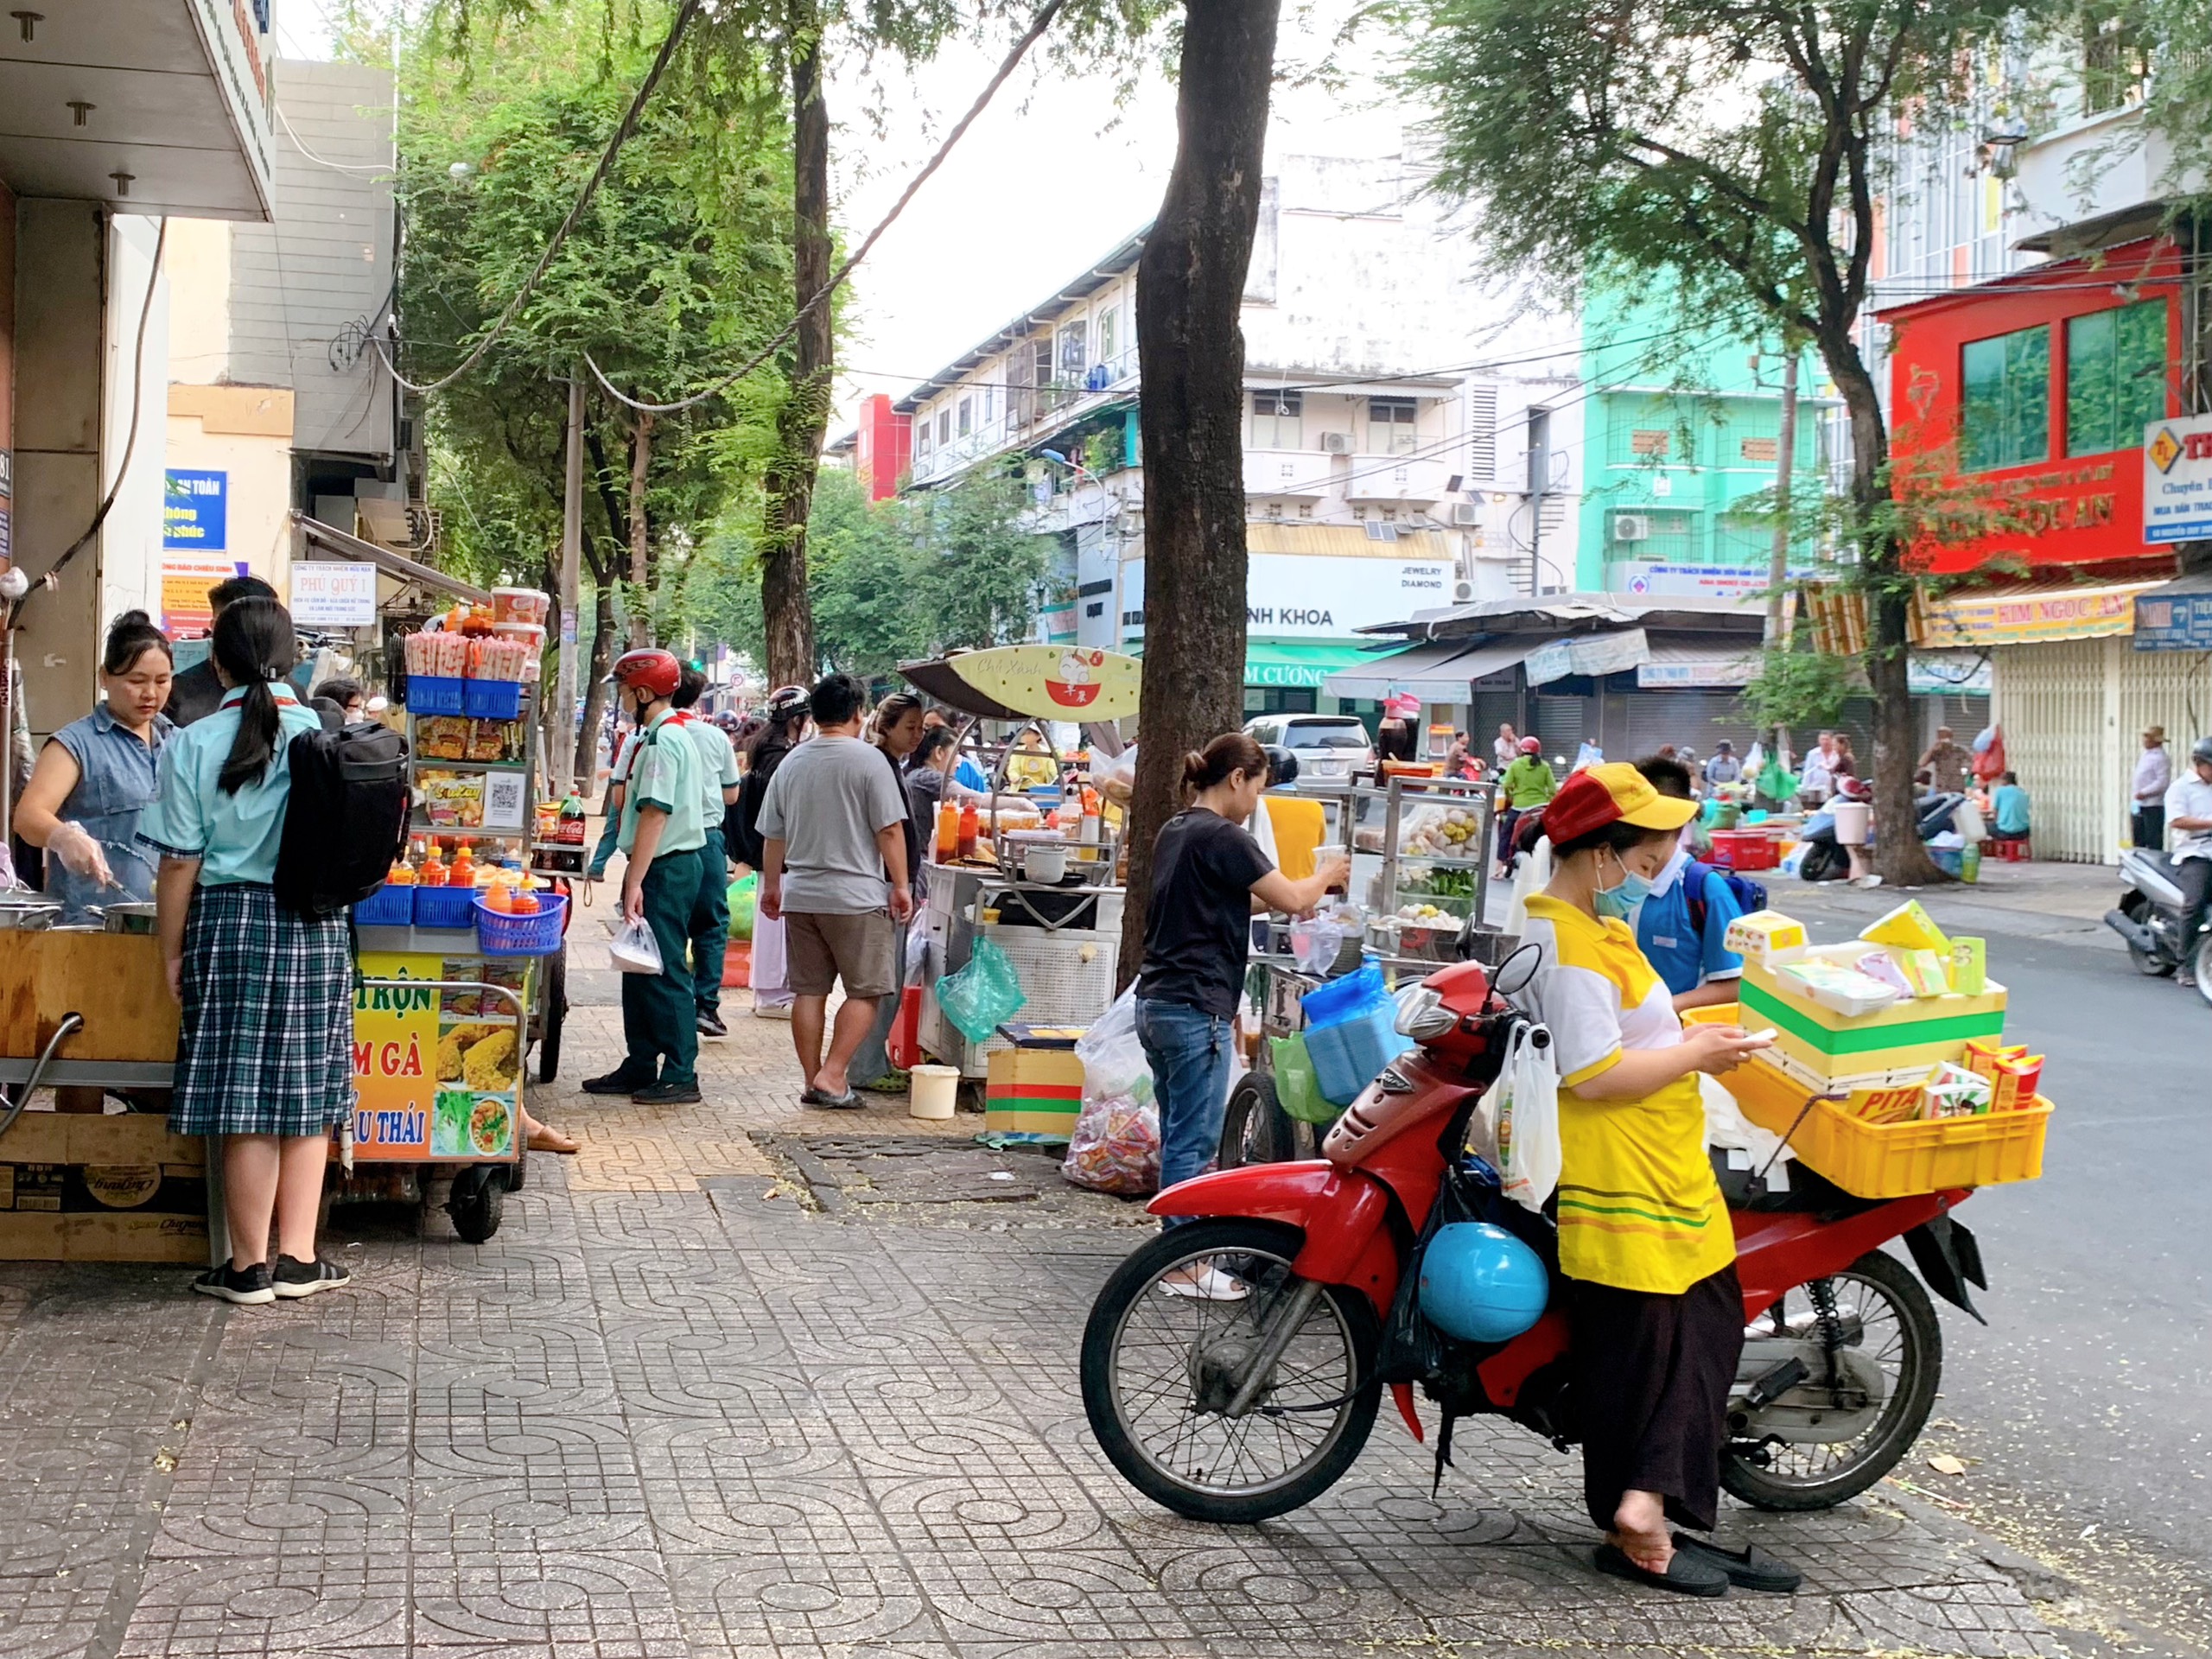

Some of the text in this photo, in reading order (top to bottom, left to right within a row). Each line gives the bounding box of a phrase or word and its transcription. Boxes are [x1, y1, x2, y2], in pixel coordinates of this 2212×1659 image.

[193, 477, 220, 495] TOÀN
[2162, 480, 2202, 495] Chuyên
[1402, 567, 1442, 575] JEWELRY
[301, 574, 326, 591] PHÚ
[331, 574, 357, 595] QUÝ
[1402, 580, 1442, 588] DIAMOND
[1280, 608, 1333, 626] KHOA
[380, 1032, 423, 1077] GÀ
[1857, 1088, 1920, 1117] PITA
[376, 1102, 425, 1144] THÁI
